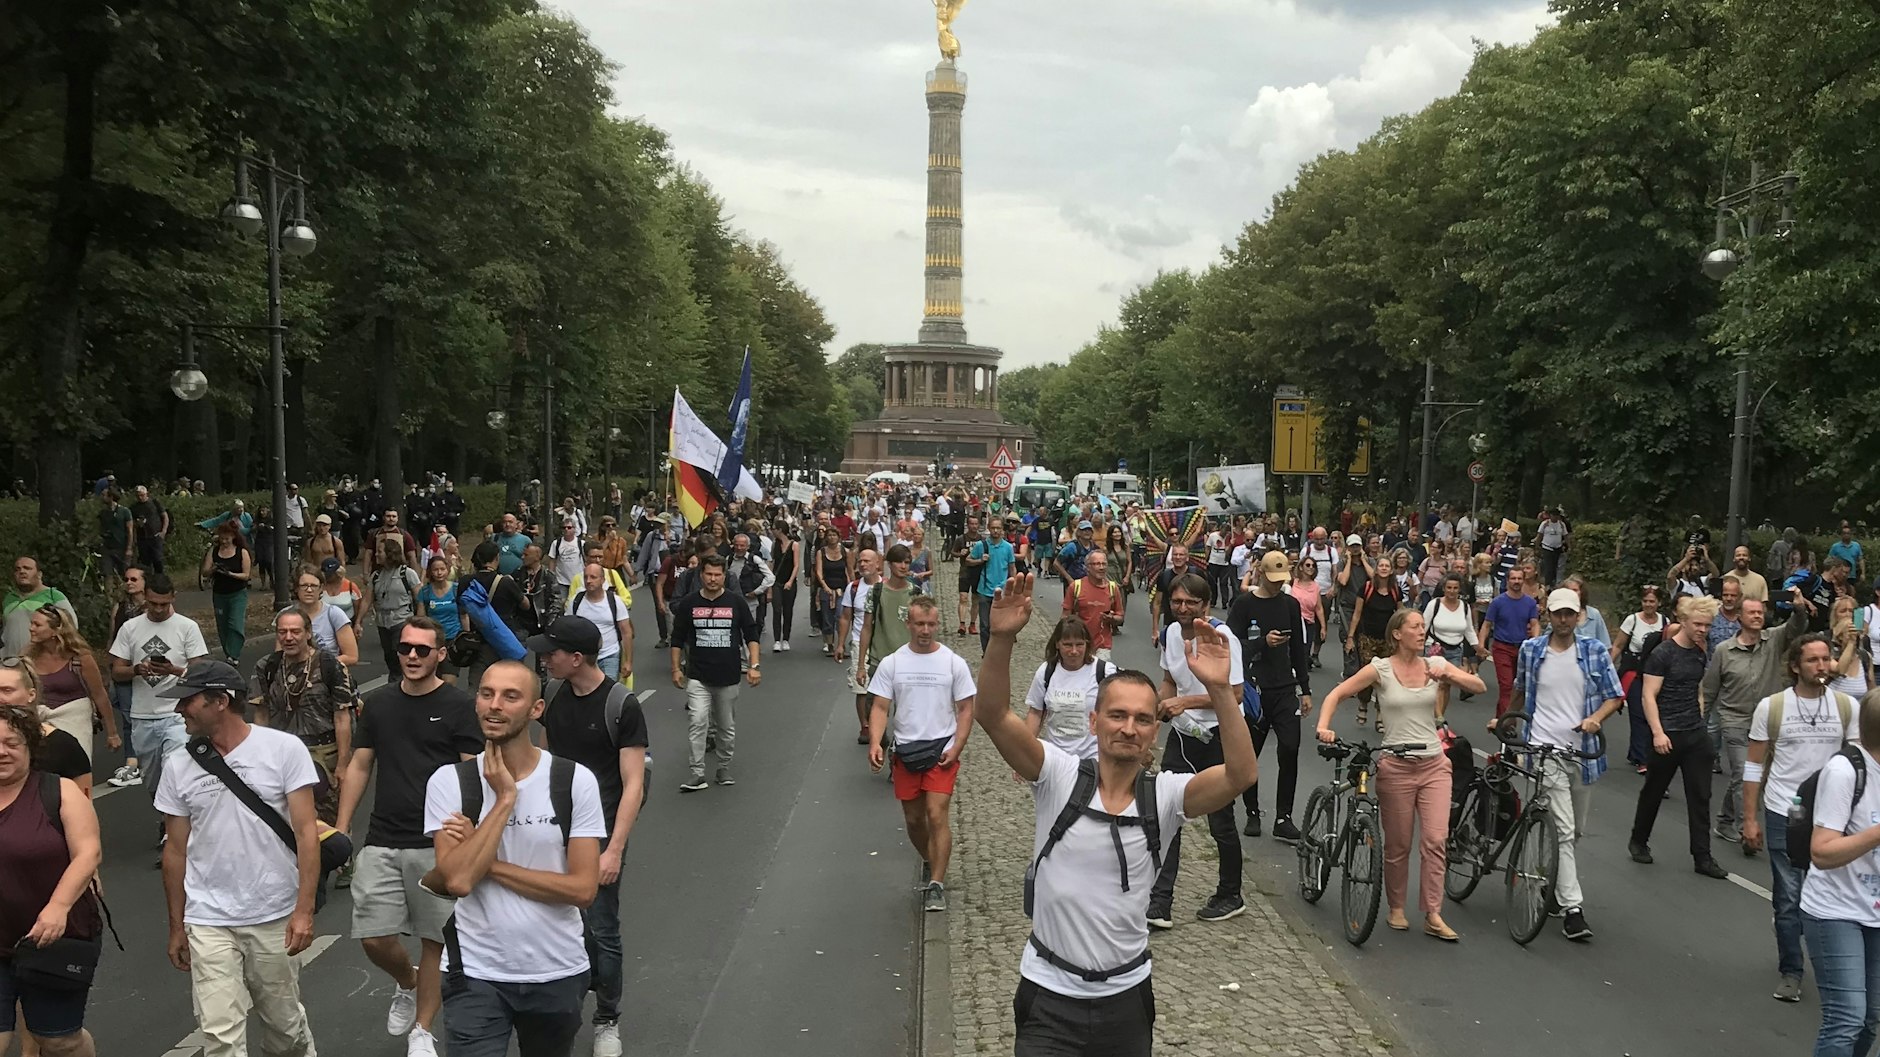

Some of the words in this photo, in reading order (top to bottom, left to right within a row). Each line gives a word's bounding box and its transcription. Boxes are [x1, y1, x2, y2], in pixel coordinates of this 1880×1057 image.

[1472, 466, 1483, 476] 30
[997, 476, 1008, 486] 30
[1054, 690, 1066, 698] ICH
[1786, 726, 1837, 734] QUERDENKEN
[200, 772, 247, 788] QUEREN
[524, 815, 533, 825] &
